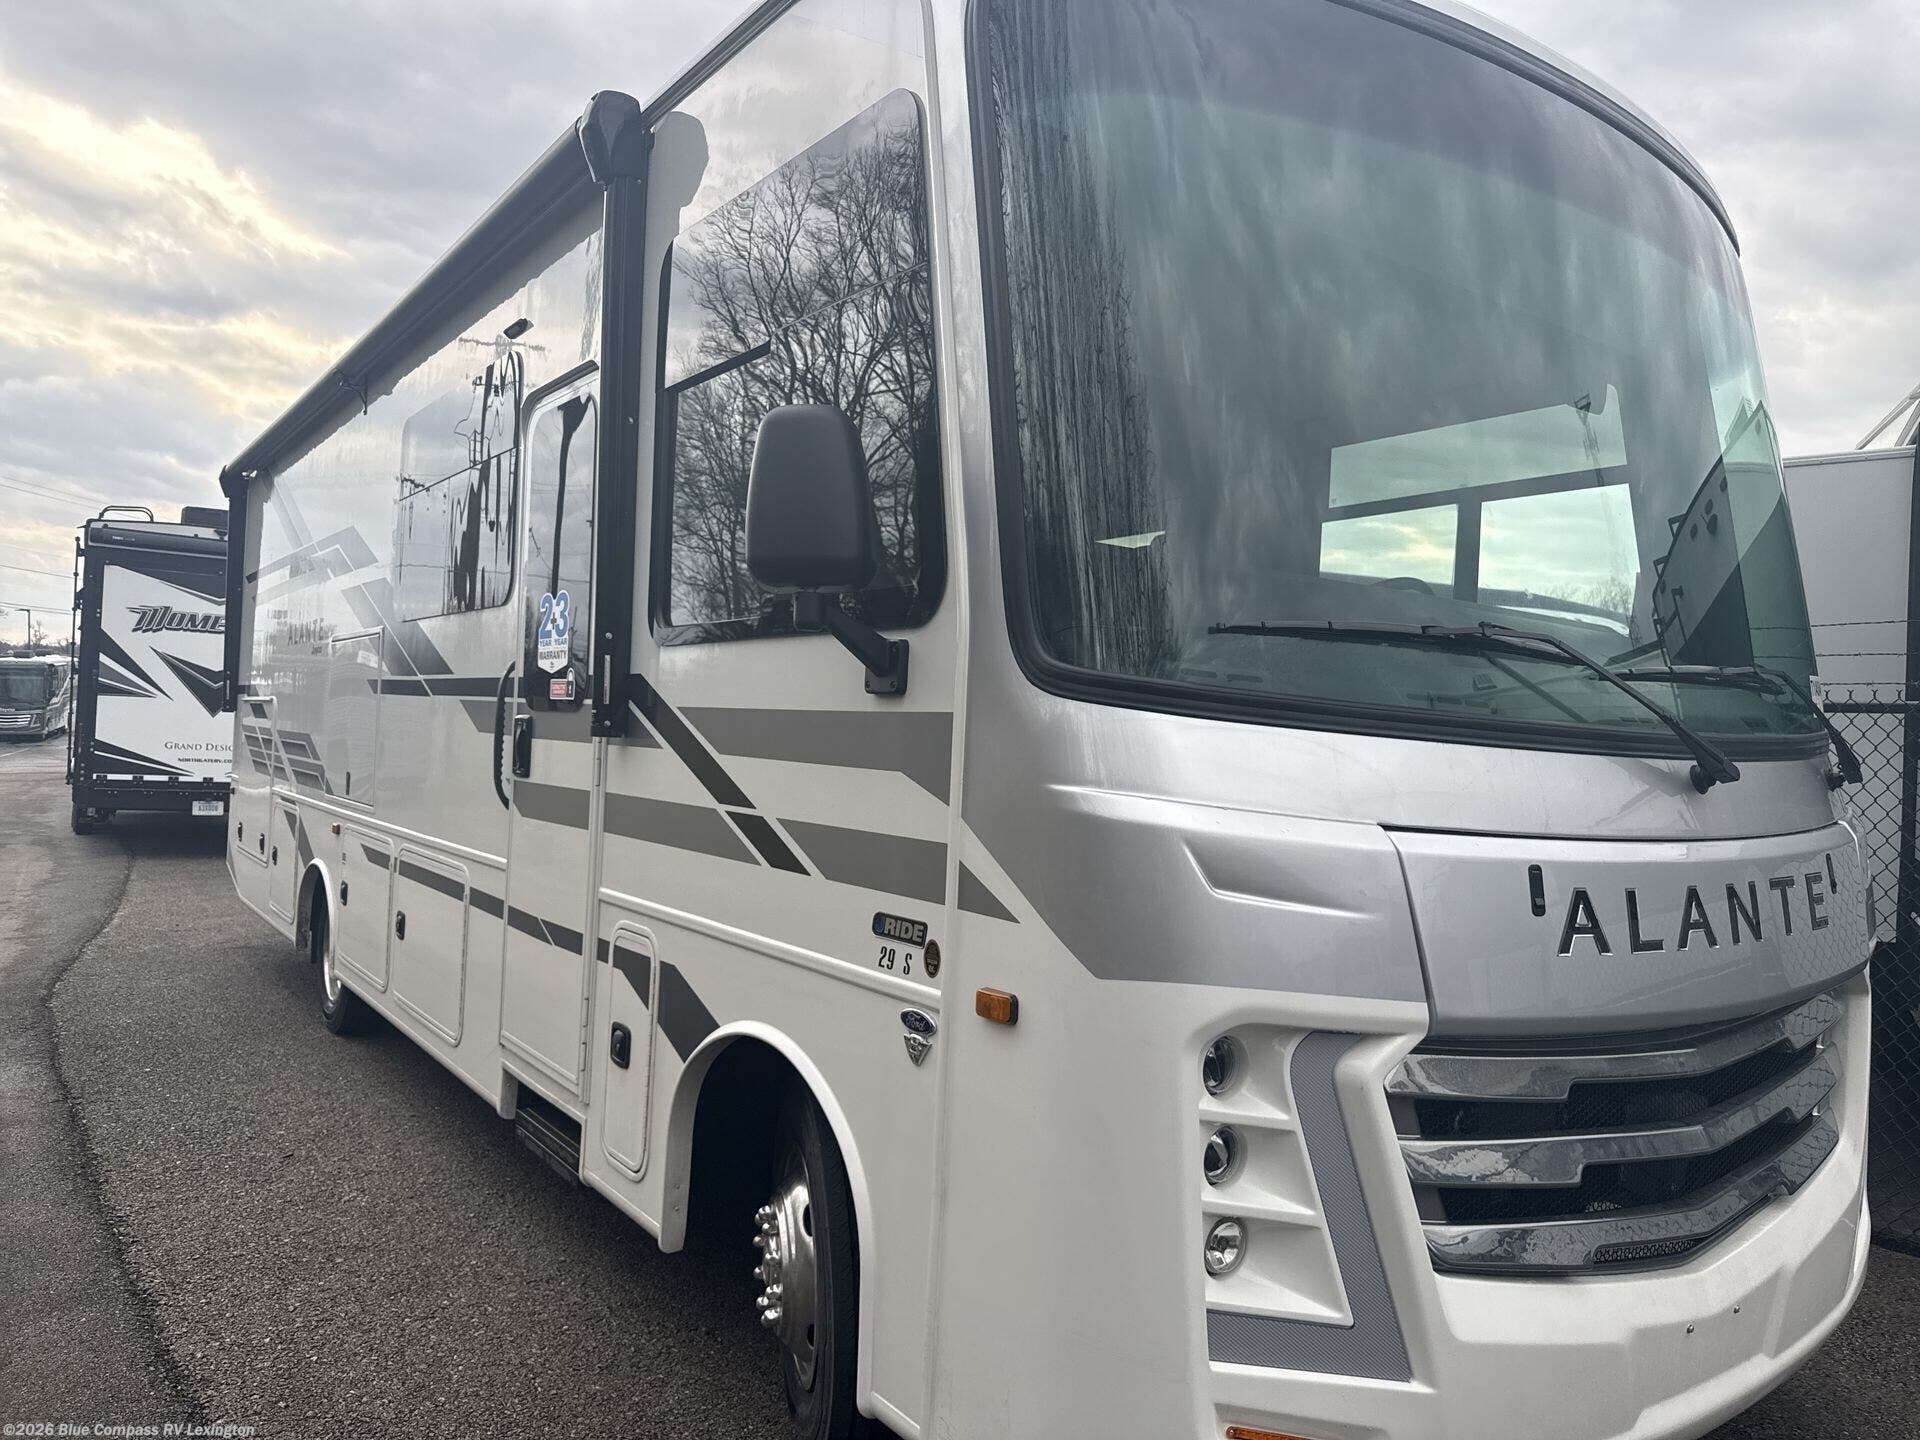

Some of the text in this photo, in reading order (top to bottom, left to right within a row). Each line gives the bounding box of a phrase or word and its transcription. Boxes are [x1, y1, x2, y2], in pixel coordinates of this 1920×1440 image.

[164, 741, 202, 751] GRAND
[1557, 871, 1830, 957] ALANTE
[878, 946, 896, 970] 29
[903, 952, 913, 975] S
[904, 1012, 928, 1031] Ford
